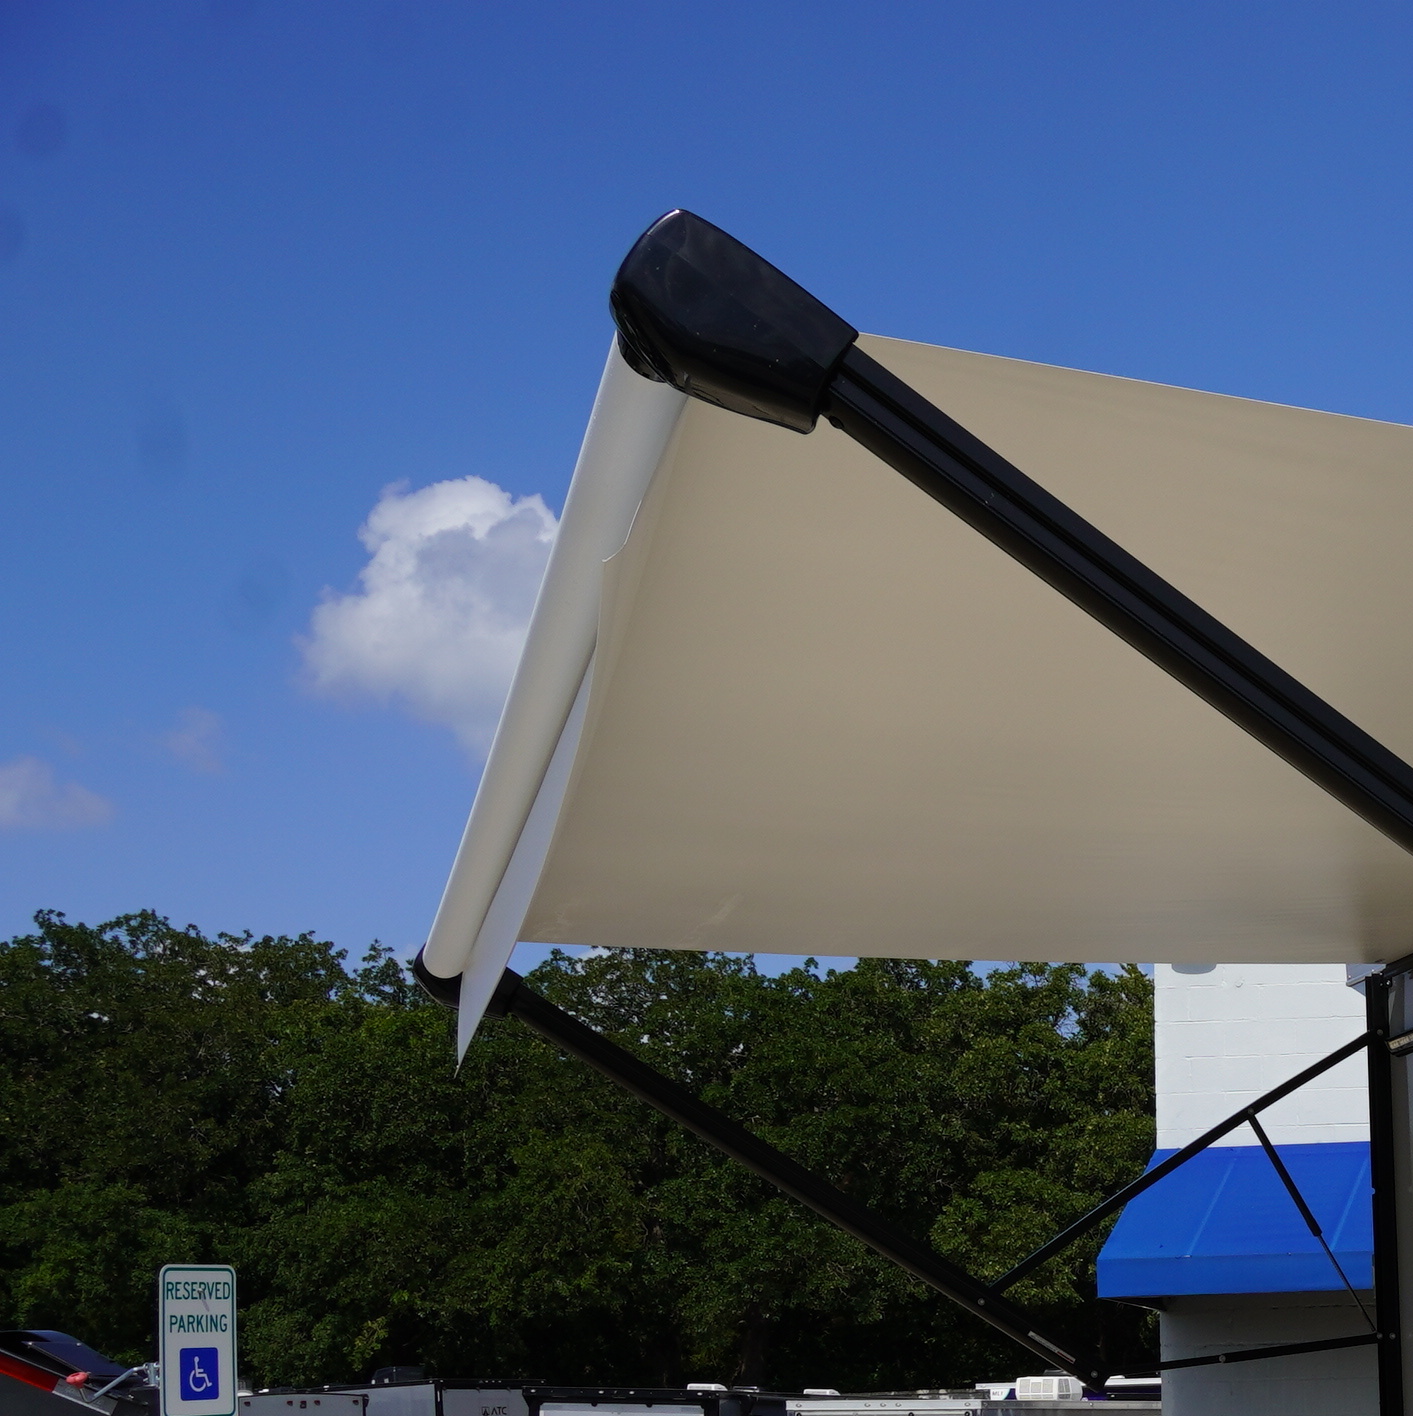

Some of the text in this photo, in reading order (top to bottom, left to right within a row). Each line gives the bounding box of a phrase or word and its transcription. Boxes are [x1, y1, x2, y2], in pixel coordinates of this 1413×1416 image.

[166, 1281, 231, 1300] RESERVED
[169, 1314, 228, 1333] PARKING
[491, 1406, 507, 1416] ATC
